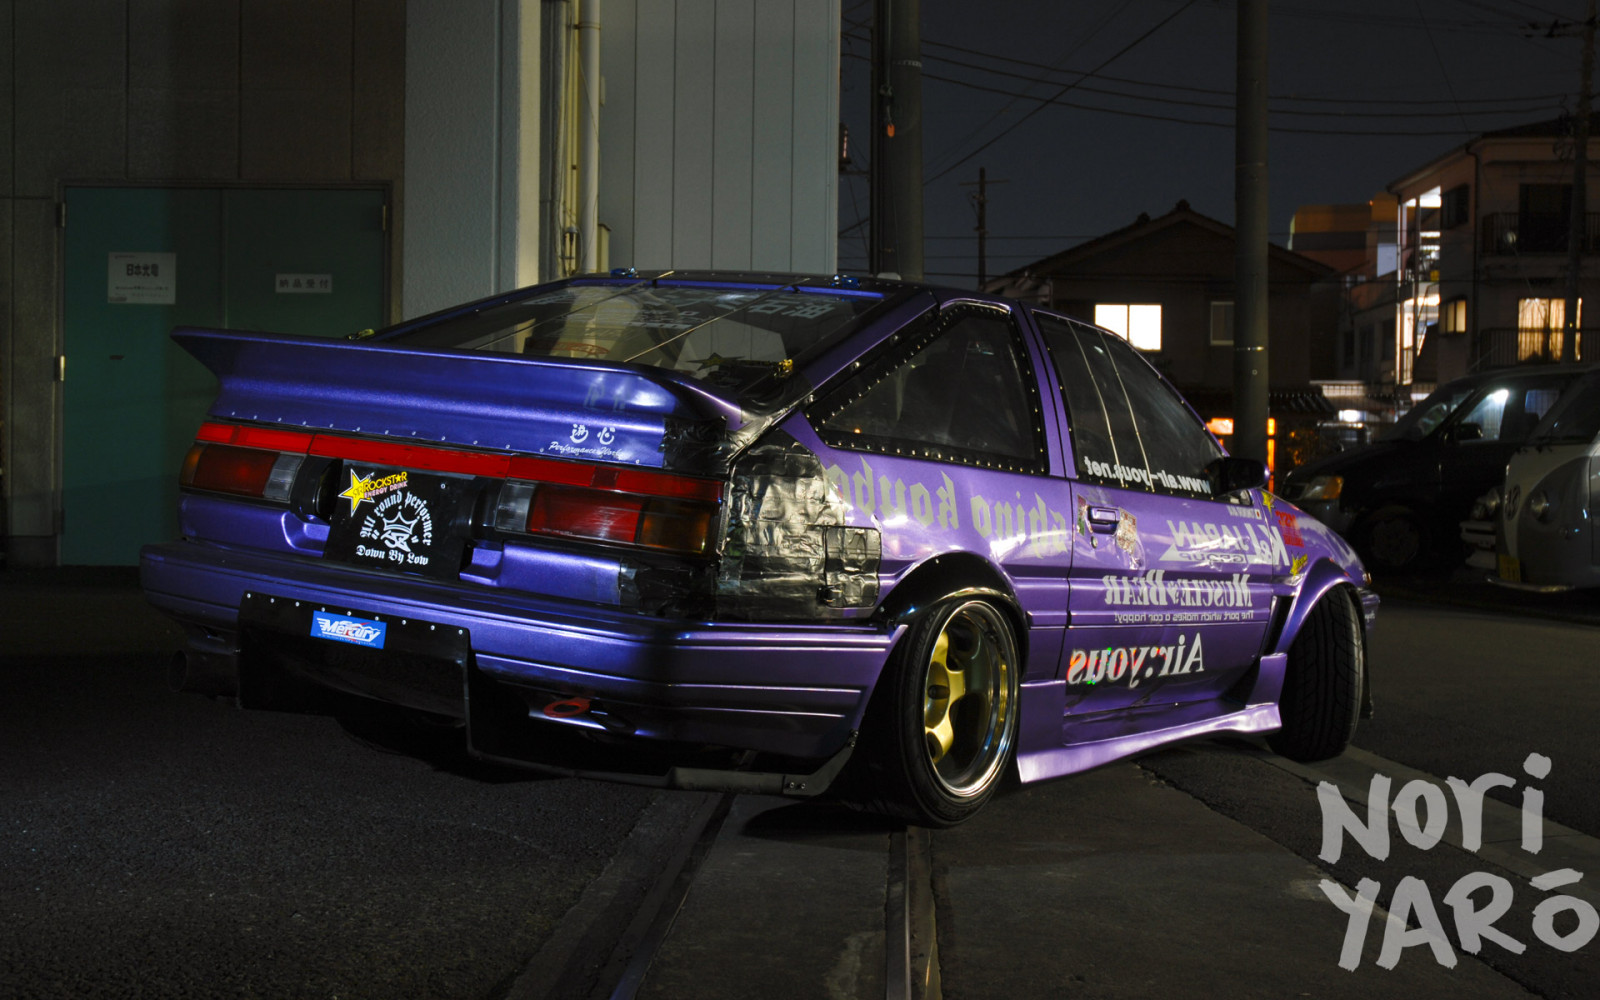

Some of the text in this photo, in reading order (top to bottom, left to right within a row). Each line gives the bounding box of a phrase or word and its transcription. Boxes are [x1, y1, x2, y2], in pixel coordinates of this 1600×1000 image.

[279, 278, 329, 289] 納品受付
[364, 480, 408, 499] ENERGY DRINK
[355, 544, 429, 566] Down By Low
[316, 617, 381, 643] Mercury
